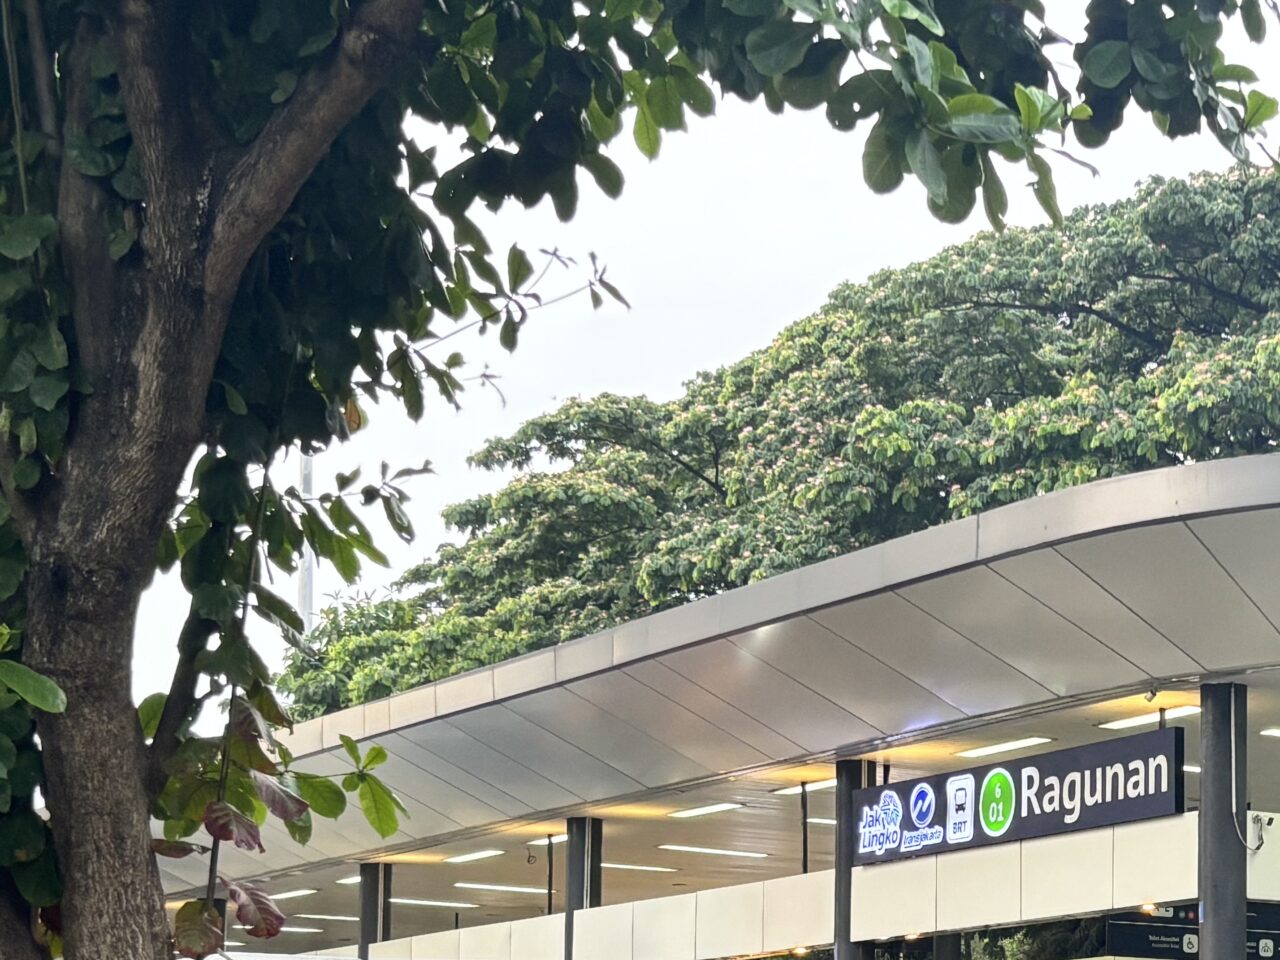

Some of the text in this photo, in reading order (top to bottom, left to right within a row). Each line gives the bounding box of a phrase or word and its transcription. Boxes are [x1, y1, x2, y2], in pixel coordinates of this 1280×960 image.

[995, 783, 1001, 799] 6
[1021, 754, 1168, 824] Ragunan
[862, 807, 881, 829] Jak
[989, 802, 1005, 823] 01
[952, 820, 968, 834] BRT
[862, 829, 898, 849] Lingko
[903, 829, 943, 849] transjakarta
